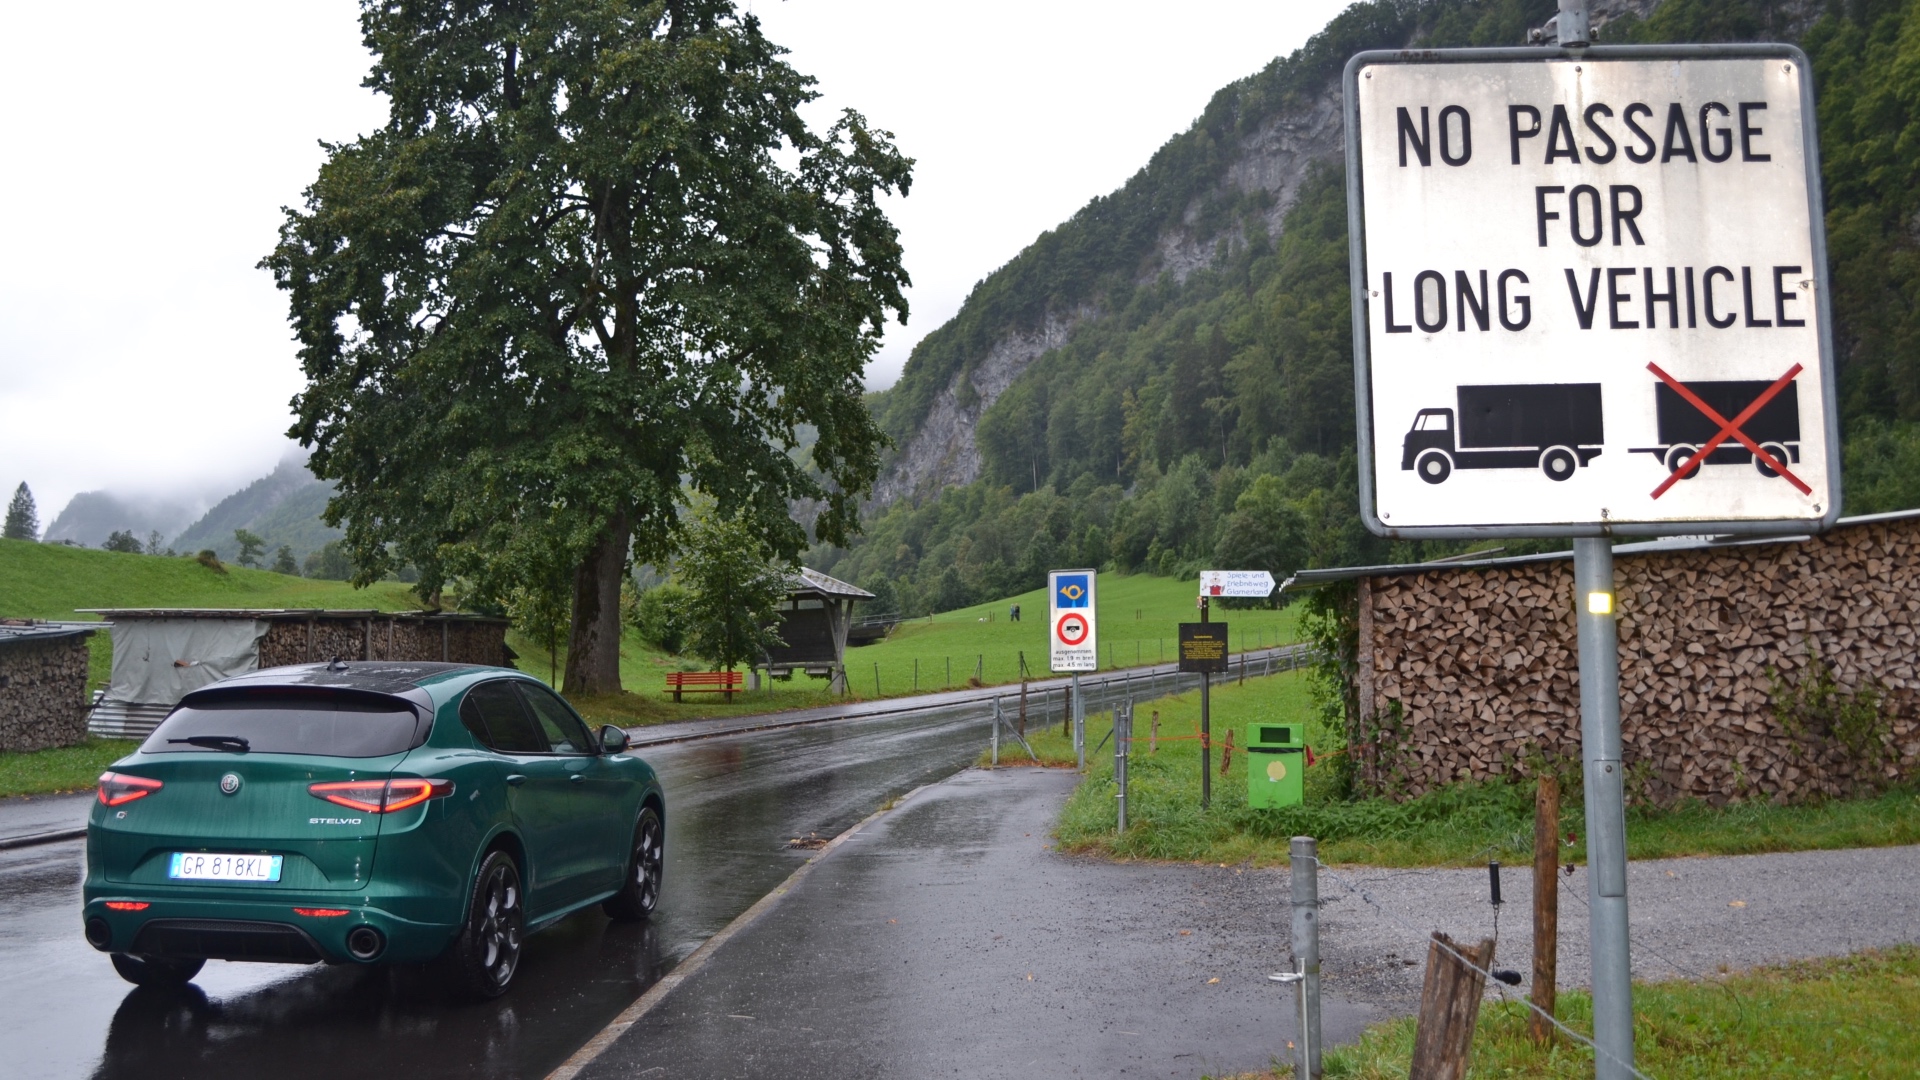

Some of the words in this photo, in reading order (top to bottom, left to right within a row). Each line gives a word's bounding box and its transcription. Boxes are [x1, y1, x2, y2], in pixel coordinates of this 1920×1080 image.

[1396, 105, 1472, 167] NO
[1508, 101, 1771, 165] PASSAGE
[1535, 184, 1646, 248] FOR
[1382, 268, 1531, 333] LONG
[1565, 265, 1806, 330] VEHICLE
[309, 817, 362, 825] STELVIO
[183, 856, 205, 875] GR
[212, 857, 266, 877] 818KL
